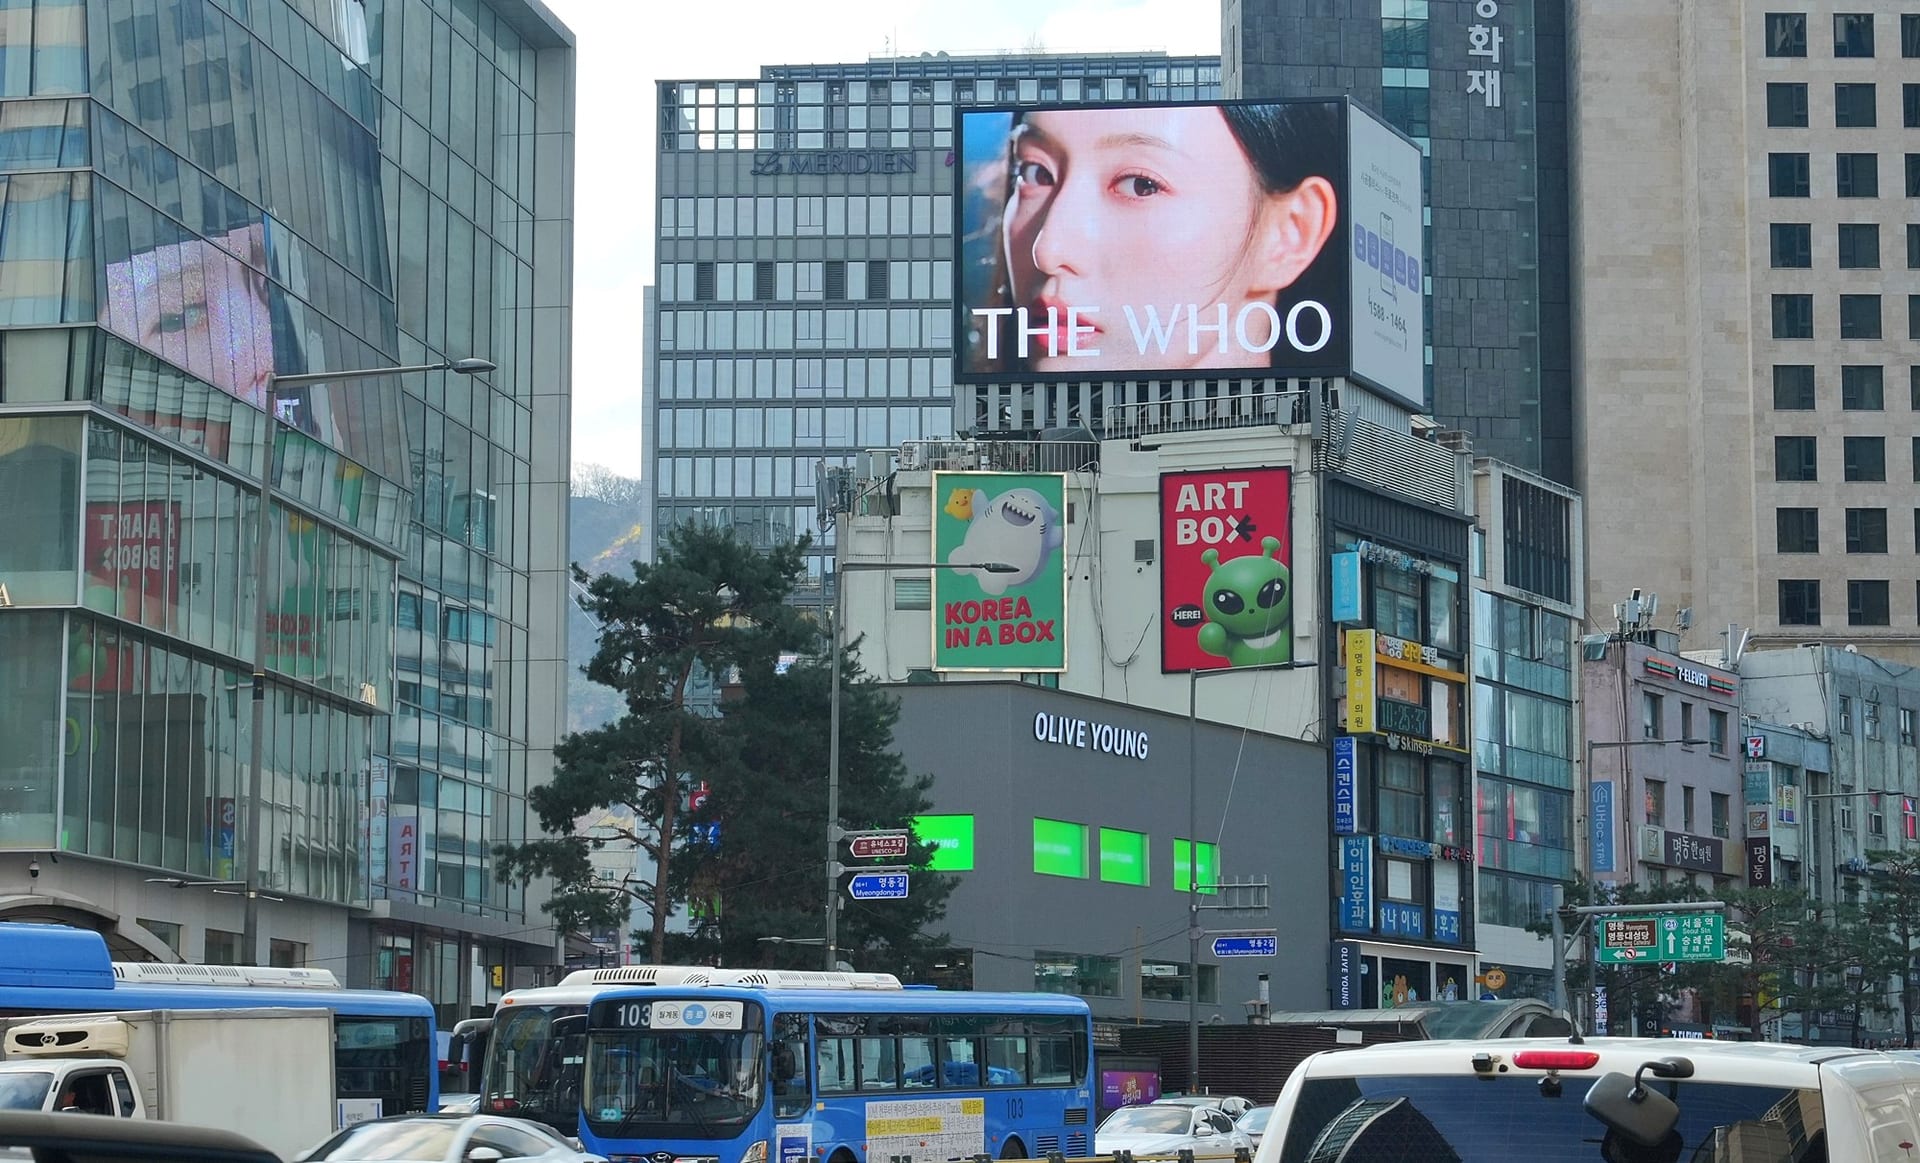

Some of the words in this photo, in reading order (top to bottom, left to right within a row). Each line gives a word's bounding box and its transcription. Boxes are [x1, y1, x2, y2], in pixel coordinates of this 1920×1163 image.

[788, 152, 916, 175] MERIDIEN
[971, 305, 1101, 359] THE
[1122, 300, 1332, 355] WHOO
[1175, 481, 1250, 513] ART
[1176, 514, 1248, 545] BOX
[945, 596, 1032, 625] KOREA
[1173, 610, 1201, 621] HERE!
[945, 627, 970, 648] IN
[975, 626, 993, 646] A
[998, 620, 1055, 645] BOX
[1677, 666, 1709, 689] 7-ELEVEN
[1034, 711, 1087, 749] OLIVE
[1090, 721, 1149, 760] YOUNG
[1401, 736, 1433, 757] Skinspa
[1337, 758, 1351, 815] 스킨스파
[870, 839, 904, 848] 유네스코길
[1672, 836, 1713, 865] 명동한의원
[1753, 846, 1766, 880] 명동
[855, 889, 905, 897] Myeongdong-gil
[879, 877, 905, 888] 명동길
[1350, 848, 1366, 919] 이비인후과
[1608, 922, 1624, 931] 명동
[1667, 920, 1676, 929] 21
[1682, 917, 1713, 927] 서울역
[1248, 939, 1274, 948] 명동2길
[1608, 932, 1649, 941] 명동대성당
[1682, 935, 1713, 945] 숭례문
[1341, 947, 1349, 974] OLIVE
[1341, 975, 1350, 1006] YOUNG
[618, 1004, 651, 1026] 103
[710, 1009, 732, 1019] 서울역
[1006, 1098, 1024, 1120] 103
